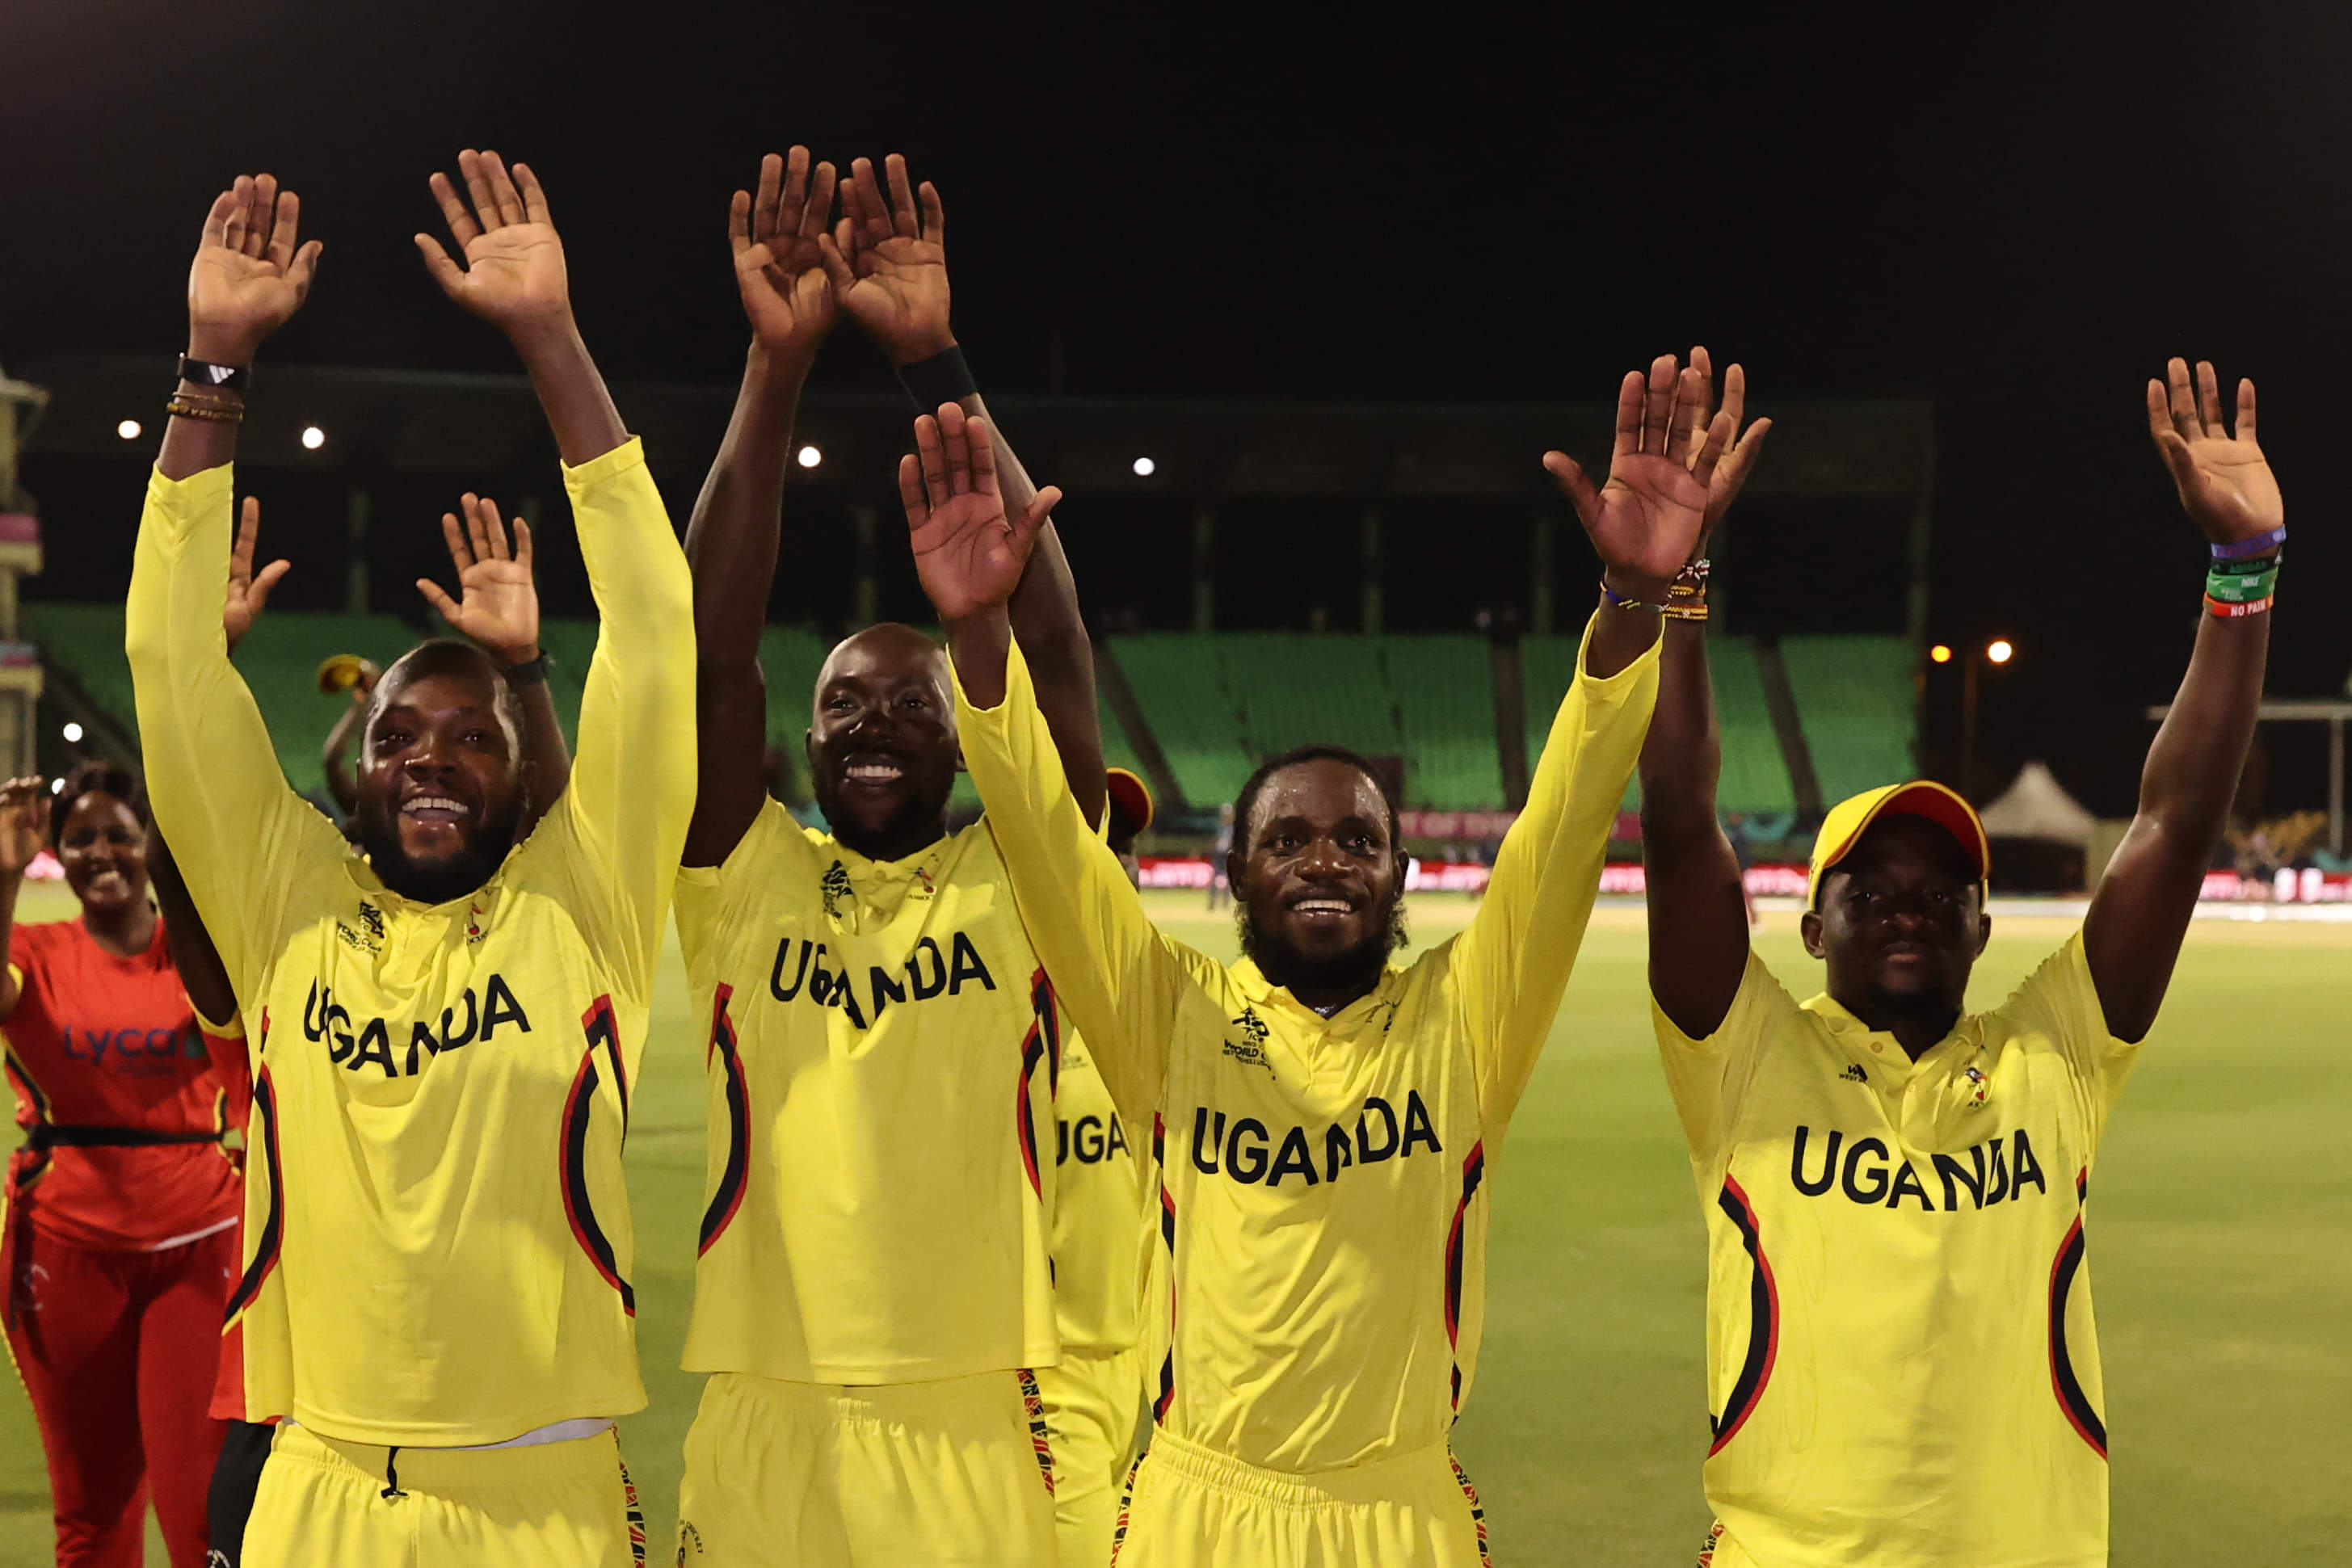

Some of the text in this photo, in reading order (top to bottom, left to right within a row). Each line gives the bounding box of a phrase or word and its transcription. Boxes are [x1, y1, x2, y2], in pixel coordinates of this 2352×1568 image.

[2230, 599, 2266, 617] NO PAIN
[304, 973, 532, 1078] UGANDA
[771, 931, 997, 1029] UGANDA
[64, 1025, 175, 1066] Lyca
[1192, 1089, 1443, 1187] UGANDA
[1791, 1125, 2046, 1212] UGANDA
